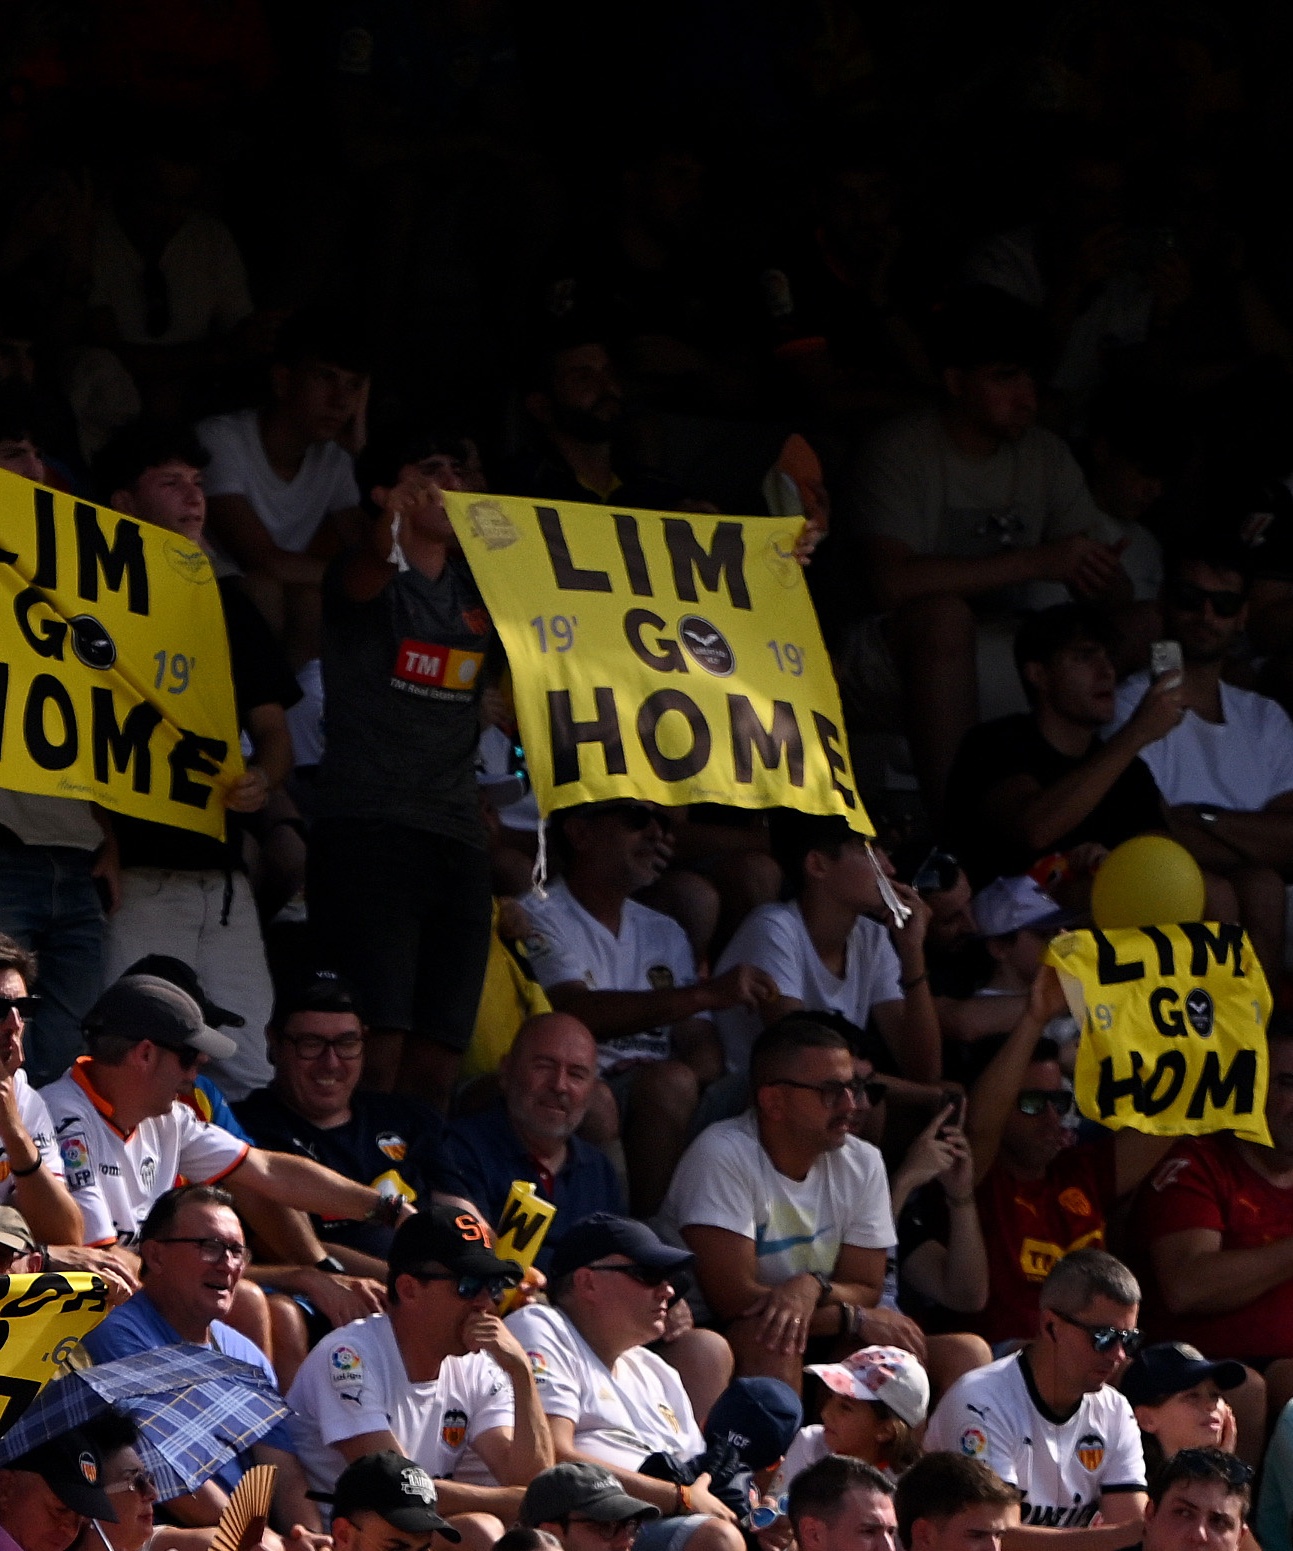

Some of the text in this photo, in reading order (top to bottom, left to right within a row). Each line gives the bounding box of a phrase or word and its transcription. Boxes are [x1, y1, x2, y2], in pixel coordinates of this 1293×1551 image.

[533, 506, 754, 611] LIM
[14, 587, 117, 670] GO
[530, 615, 579, 654] 19'
[624, 608, 737, 678] GO
[153, 649, 195, 695] 19'
[404, 651, 442, 678] TM
[767, 639, 805, 677] 19'
[547, 687, 855, 811] HOME
[1093, 922, 1246, 985] LIM
[1150, 987, 1214, 1039] GO
[68, 1170, 91, 1188] LFP
